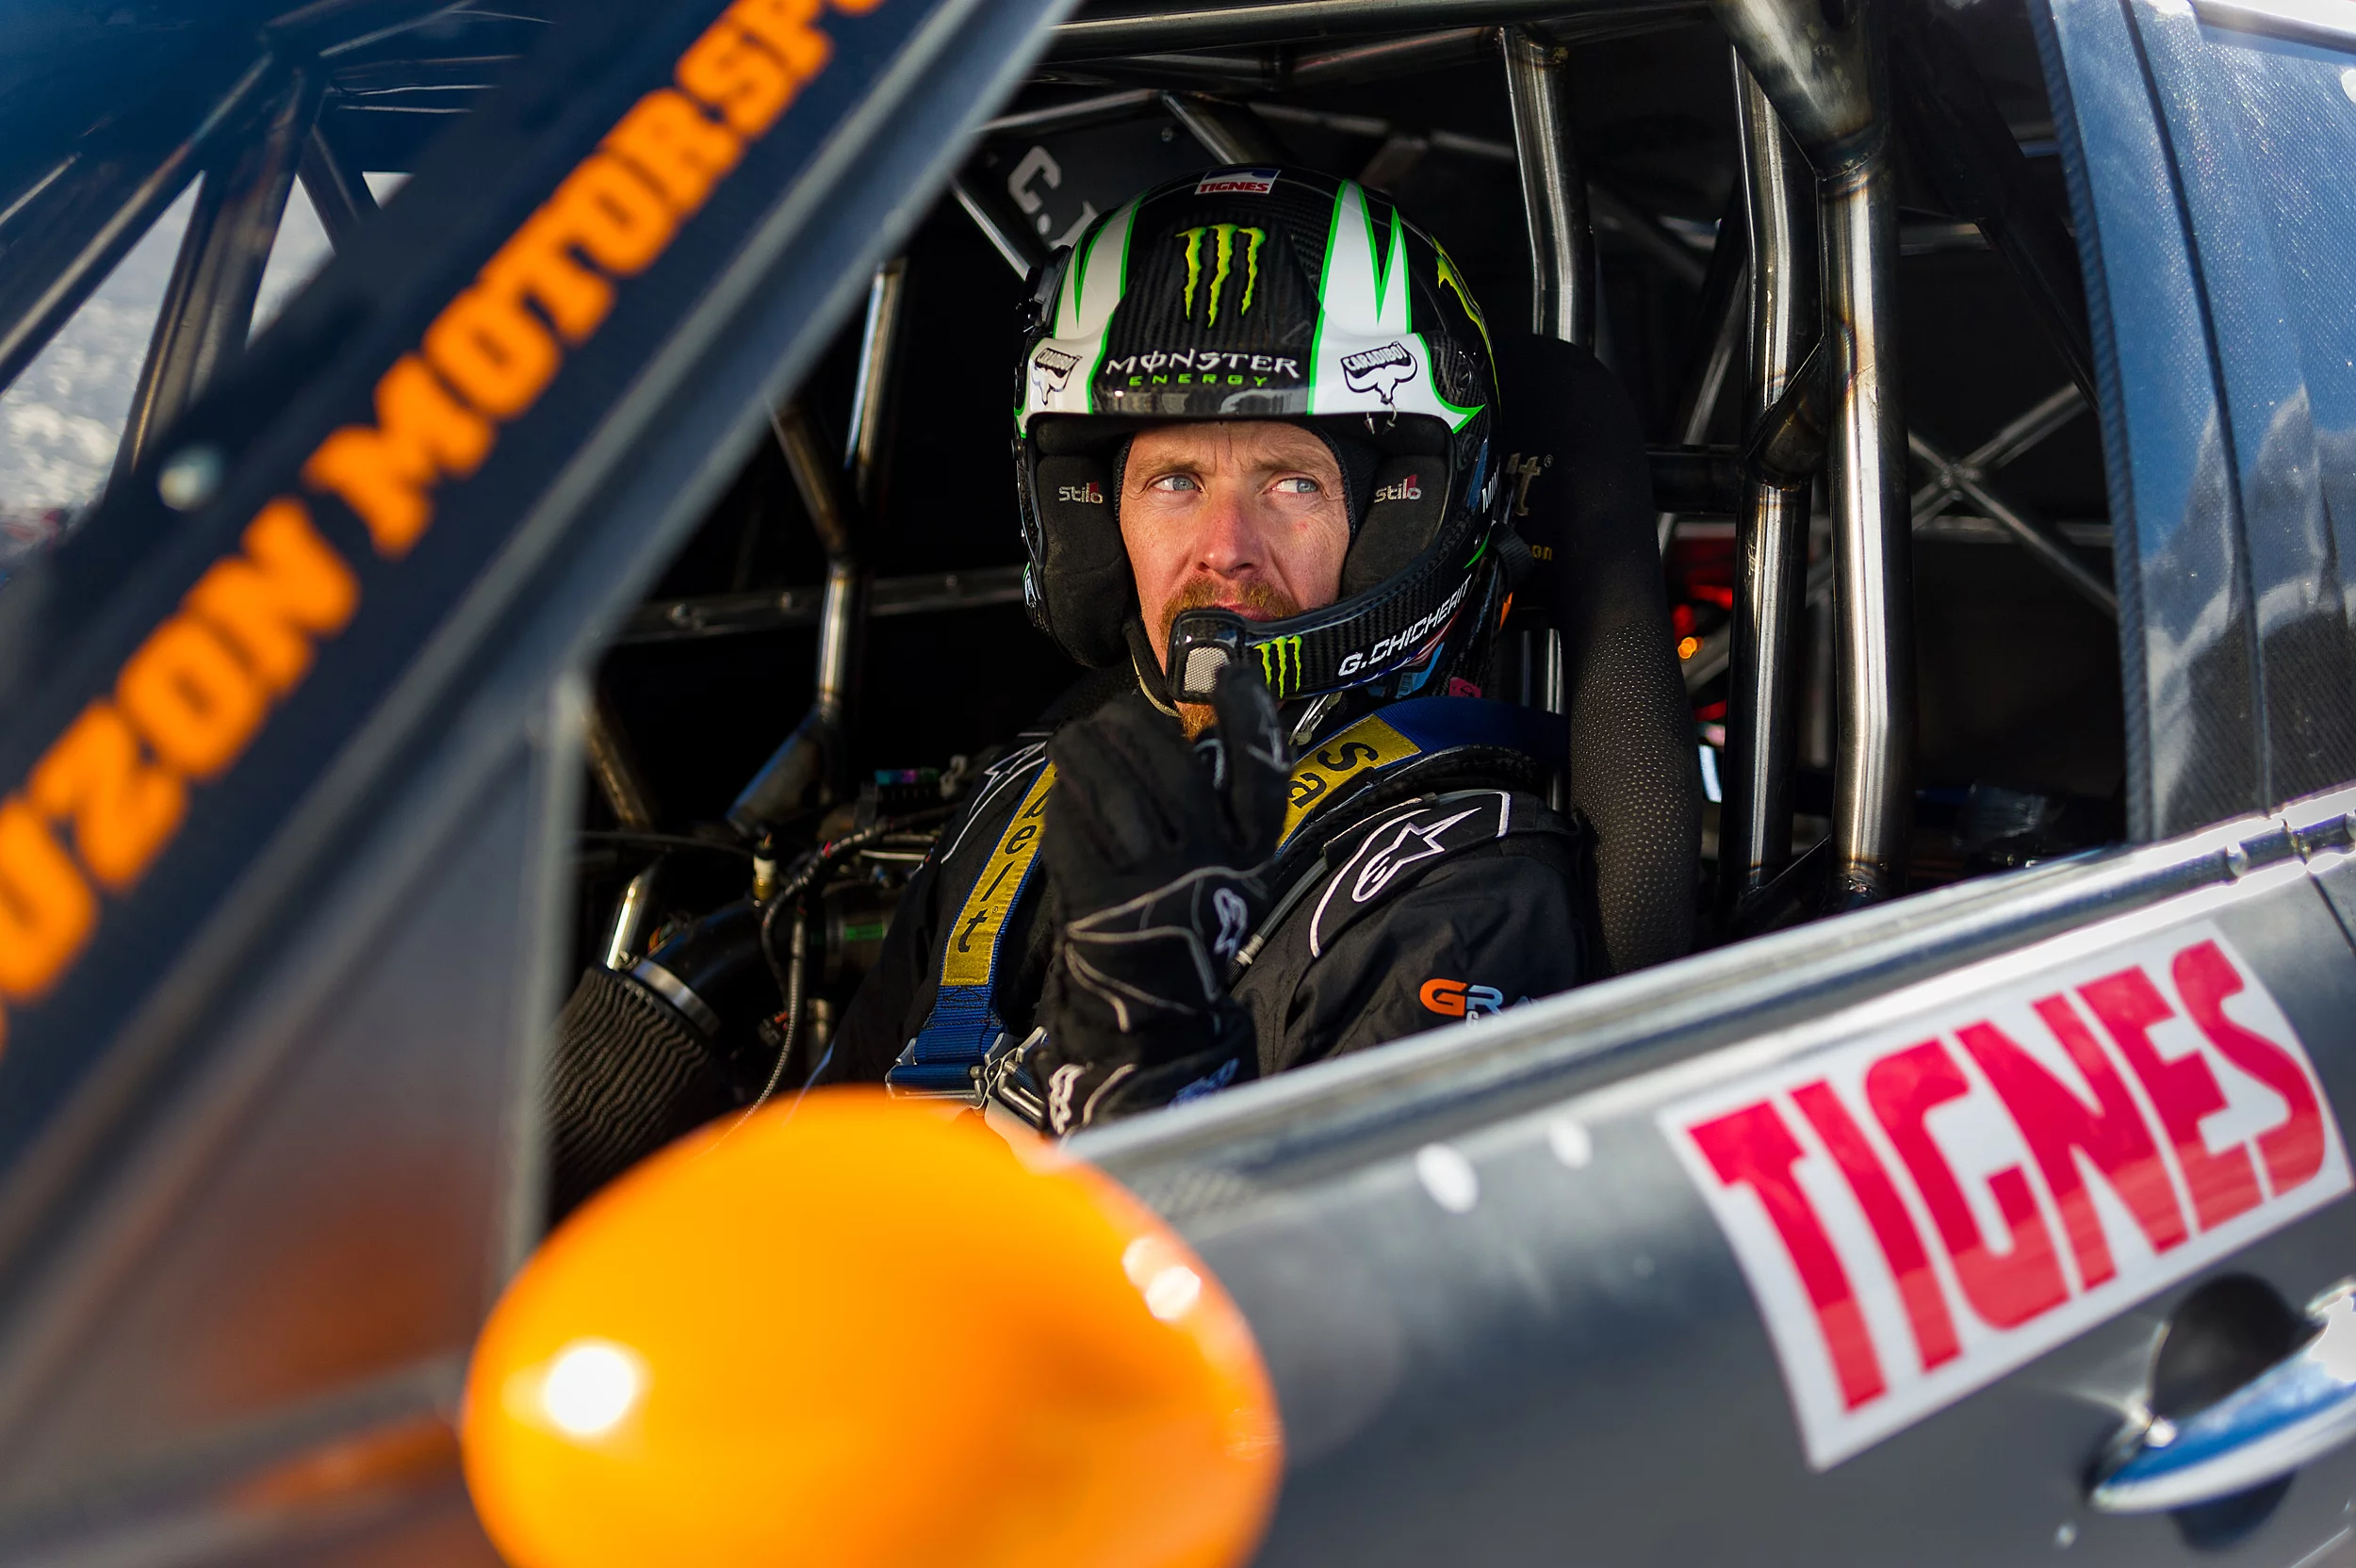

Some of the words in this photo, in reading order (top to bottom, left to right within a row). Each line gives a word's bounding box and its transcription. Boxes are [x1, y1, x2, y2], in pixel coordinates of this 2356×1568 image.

[1199, 181, 1270, 194] TIGNES
[1128, 373, 1268, 387] ENERGY
[1530, 544, 1554, 562] on
[0, 498, 360, 1048] UZON
[957, 786, 1052, 954] belt
[1686, 939, 2327, 1415] TIGNES
